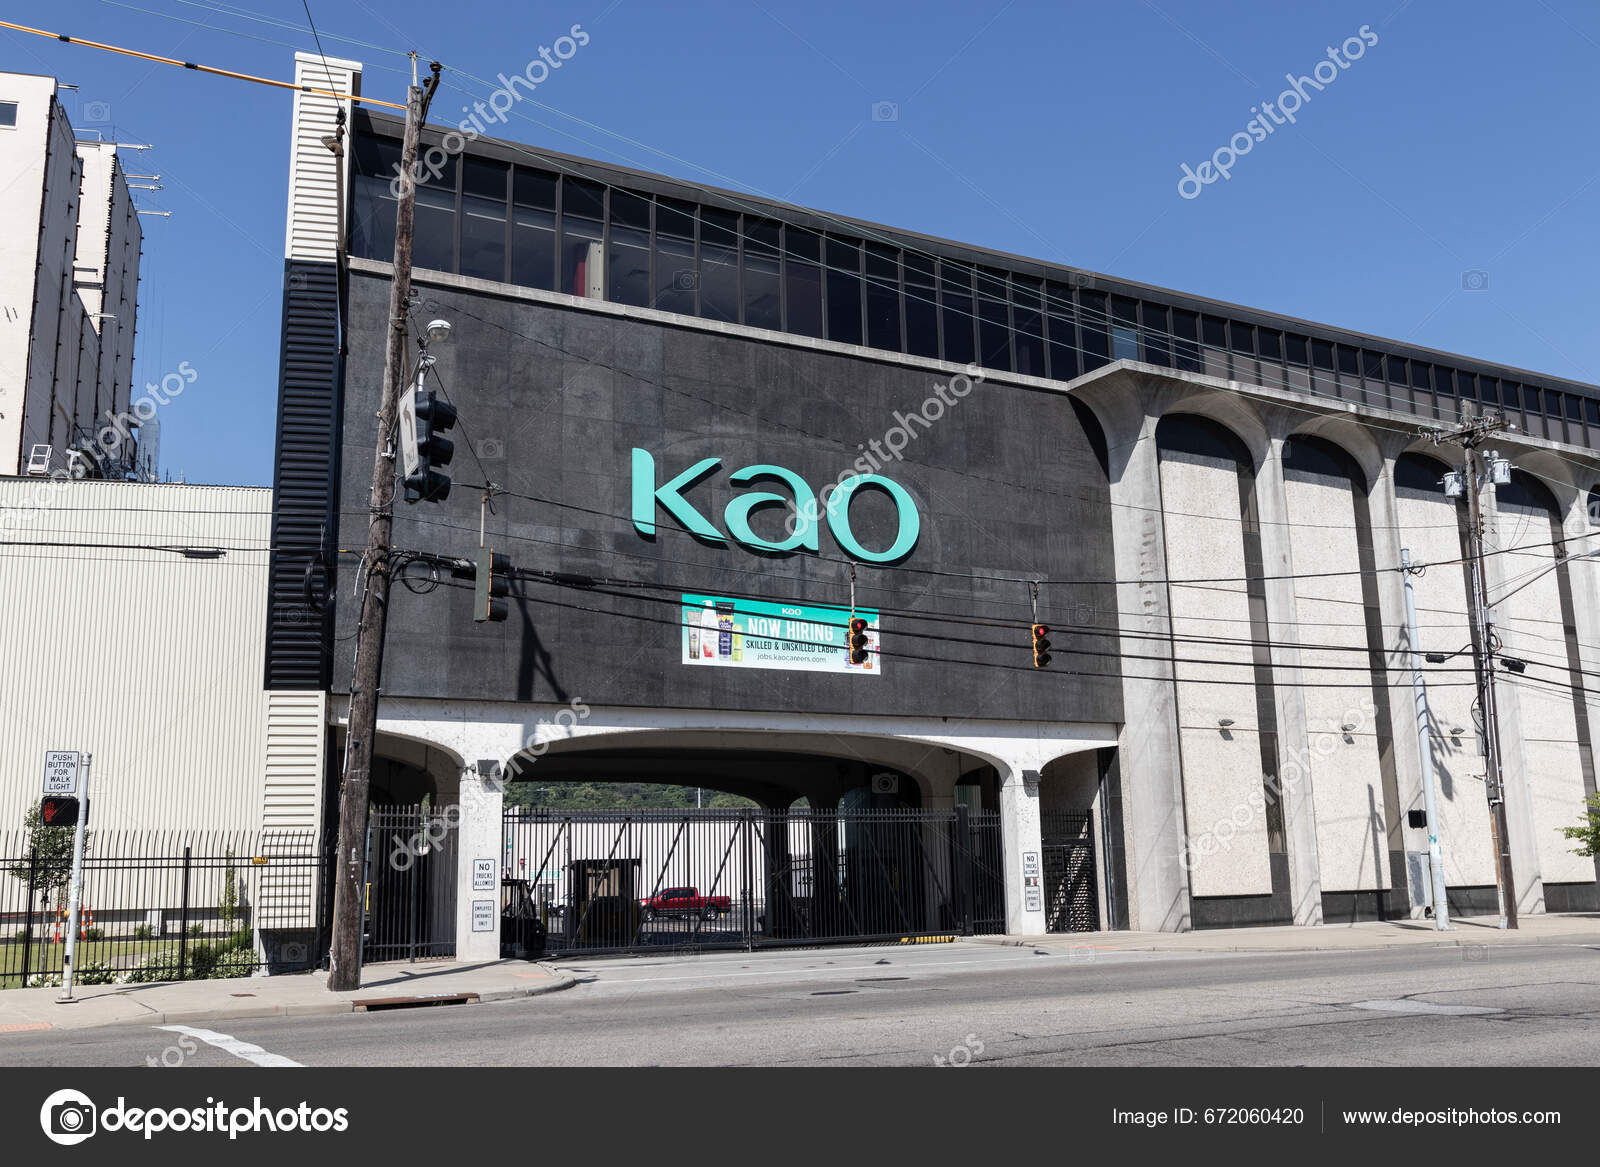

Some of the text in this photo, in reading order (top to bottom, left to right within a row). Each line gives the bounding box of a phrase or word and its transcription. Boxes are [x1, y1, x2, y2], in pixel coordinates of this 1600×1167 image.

[631, 447, 921, 563] kao
[748, 617, 833, 641] NOW HIRING
[745, 639, 838, 654] SKILLED & UNSKILLED LABOR
[757, 652, 827, 664] jobs.kaocareers.com
[479, 863, 490, 871] NO
